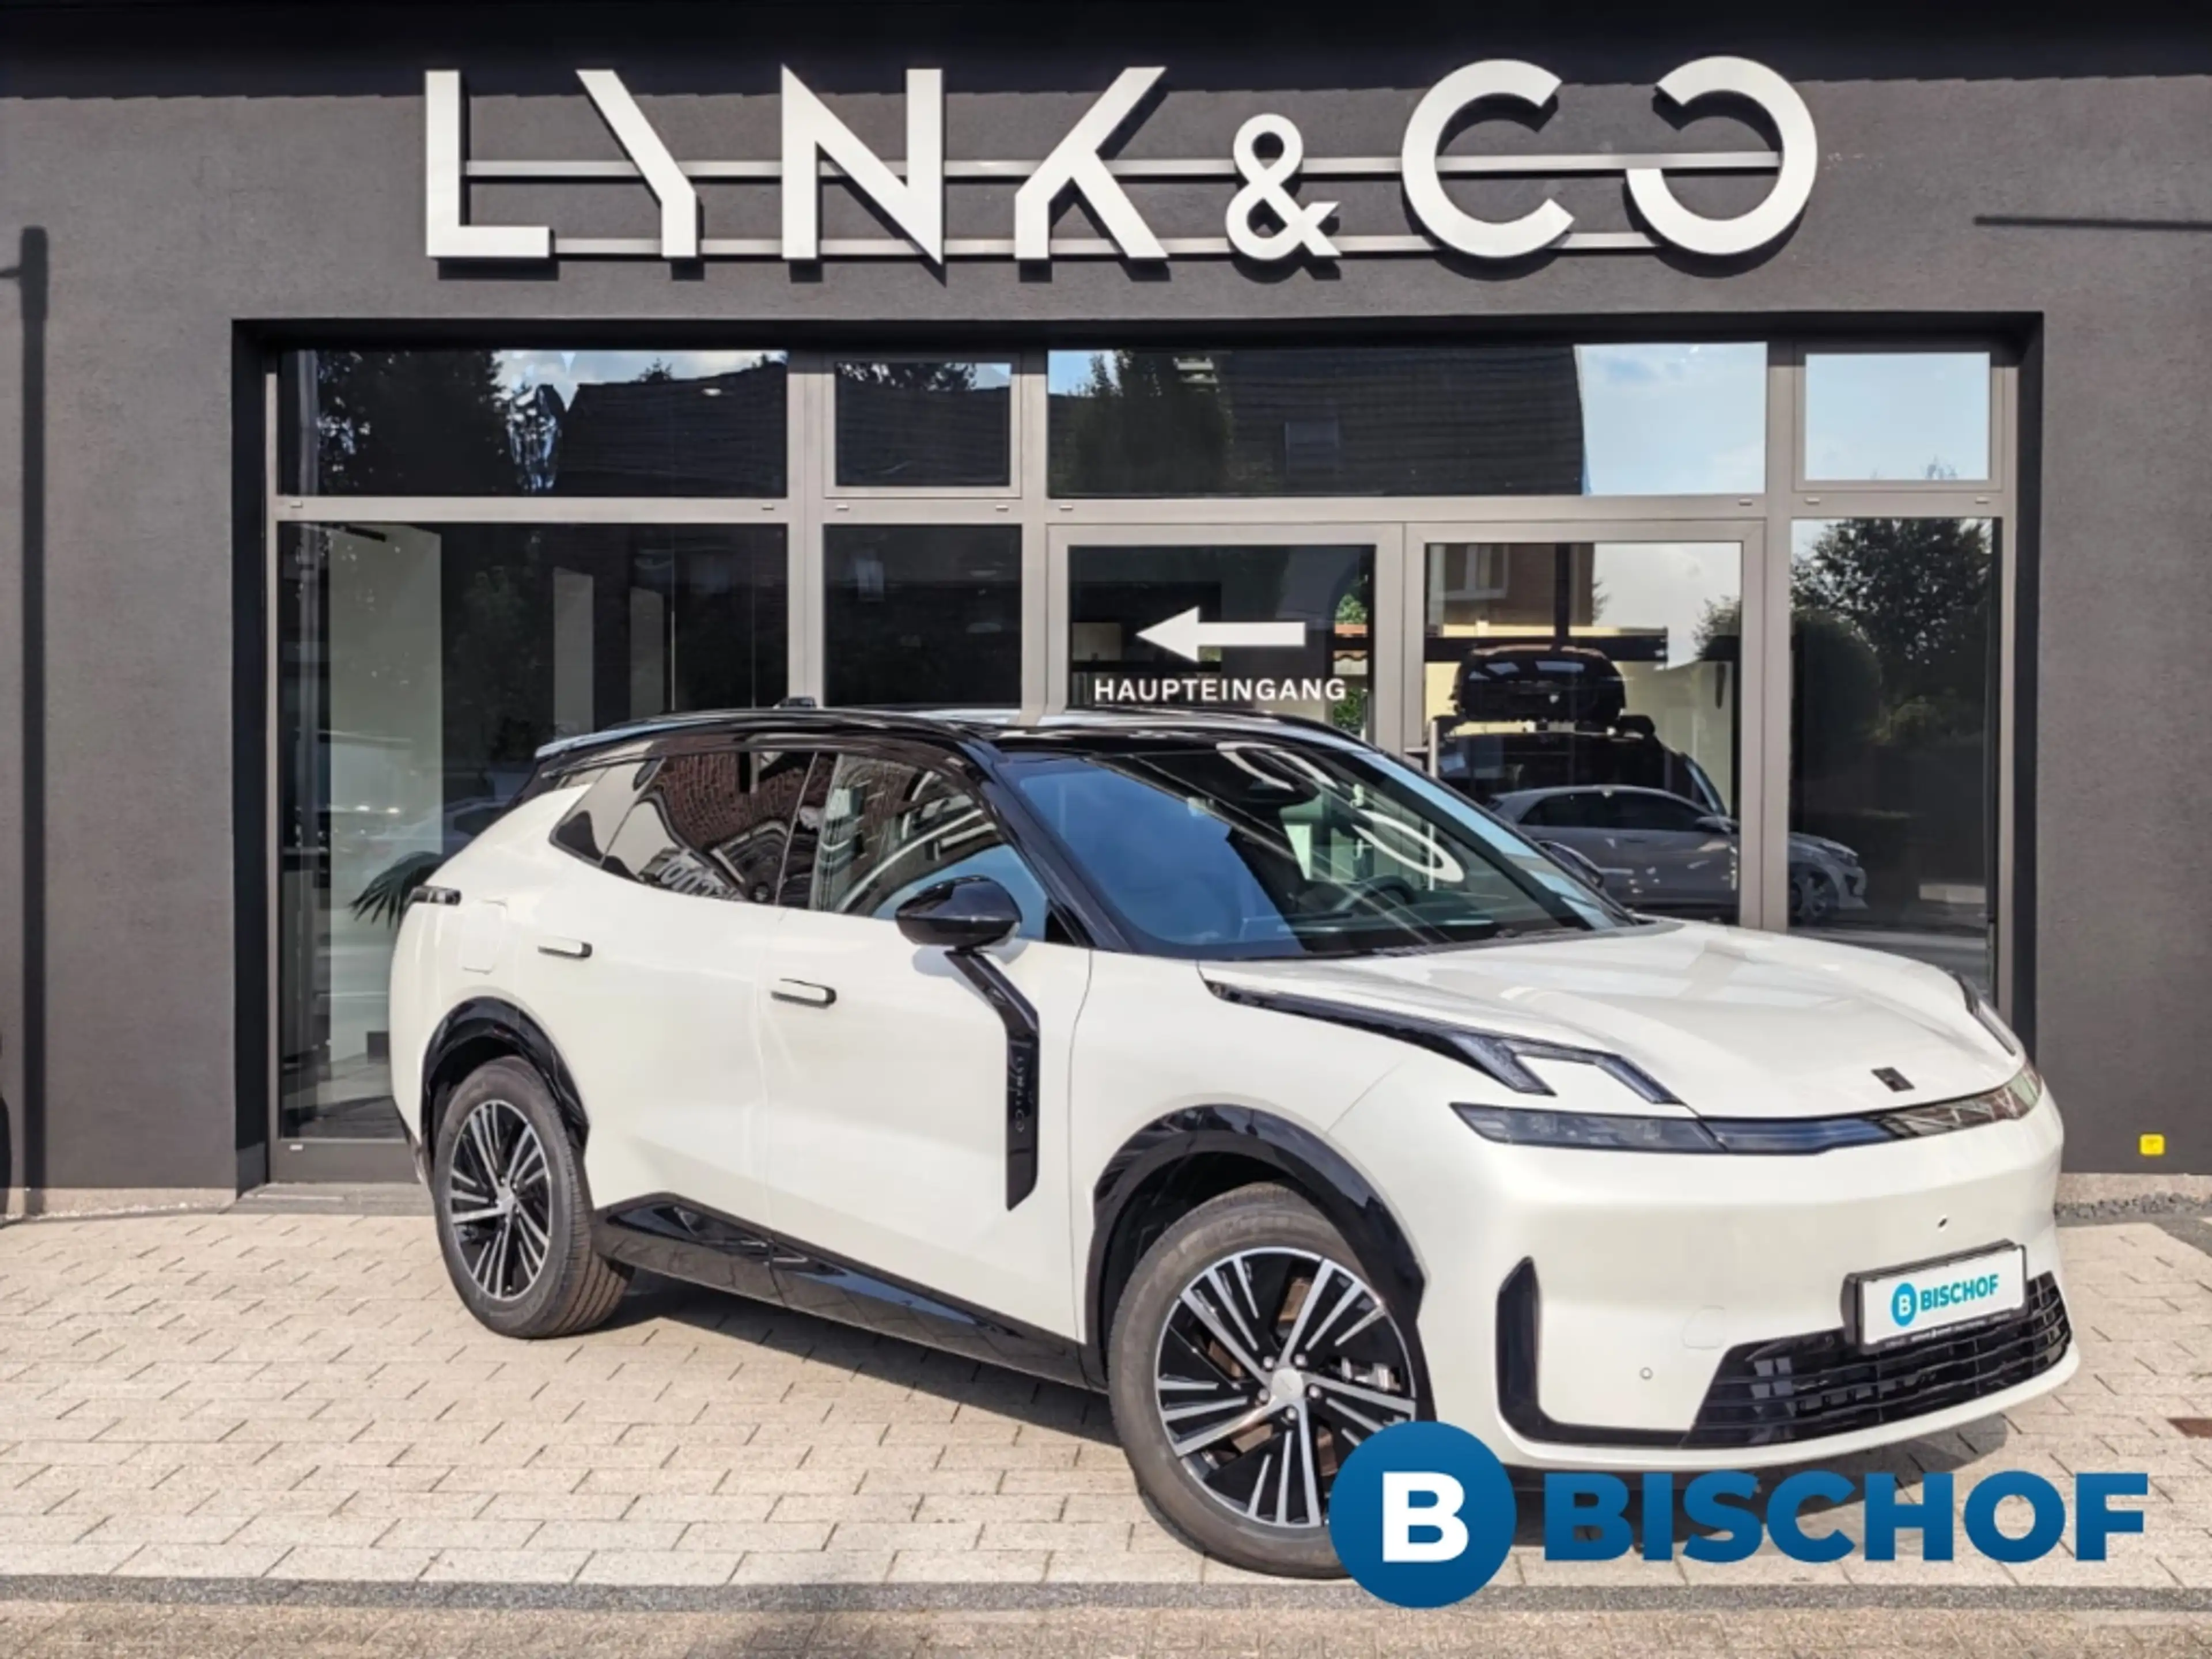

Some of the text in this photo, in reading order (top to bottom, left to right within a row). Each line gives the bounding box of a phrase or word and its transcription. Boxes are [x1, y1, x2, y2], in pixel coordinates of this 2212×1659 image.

[425, 65, 1169, 265] LYNK
[1225, 113, 1340, 260] &
[1094, 677, 1347, 702] HAUPTEINGANG
[1919, 1274, 1999, 1312] BISCHOF
